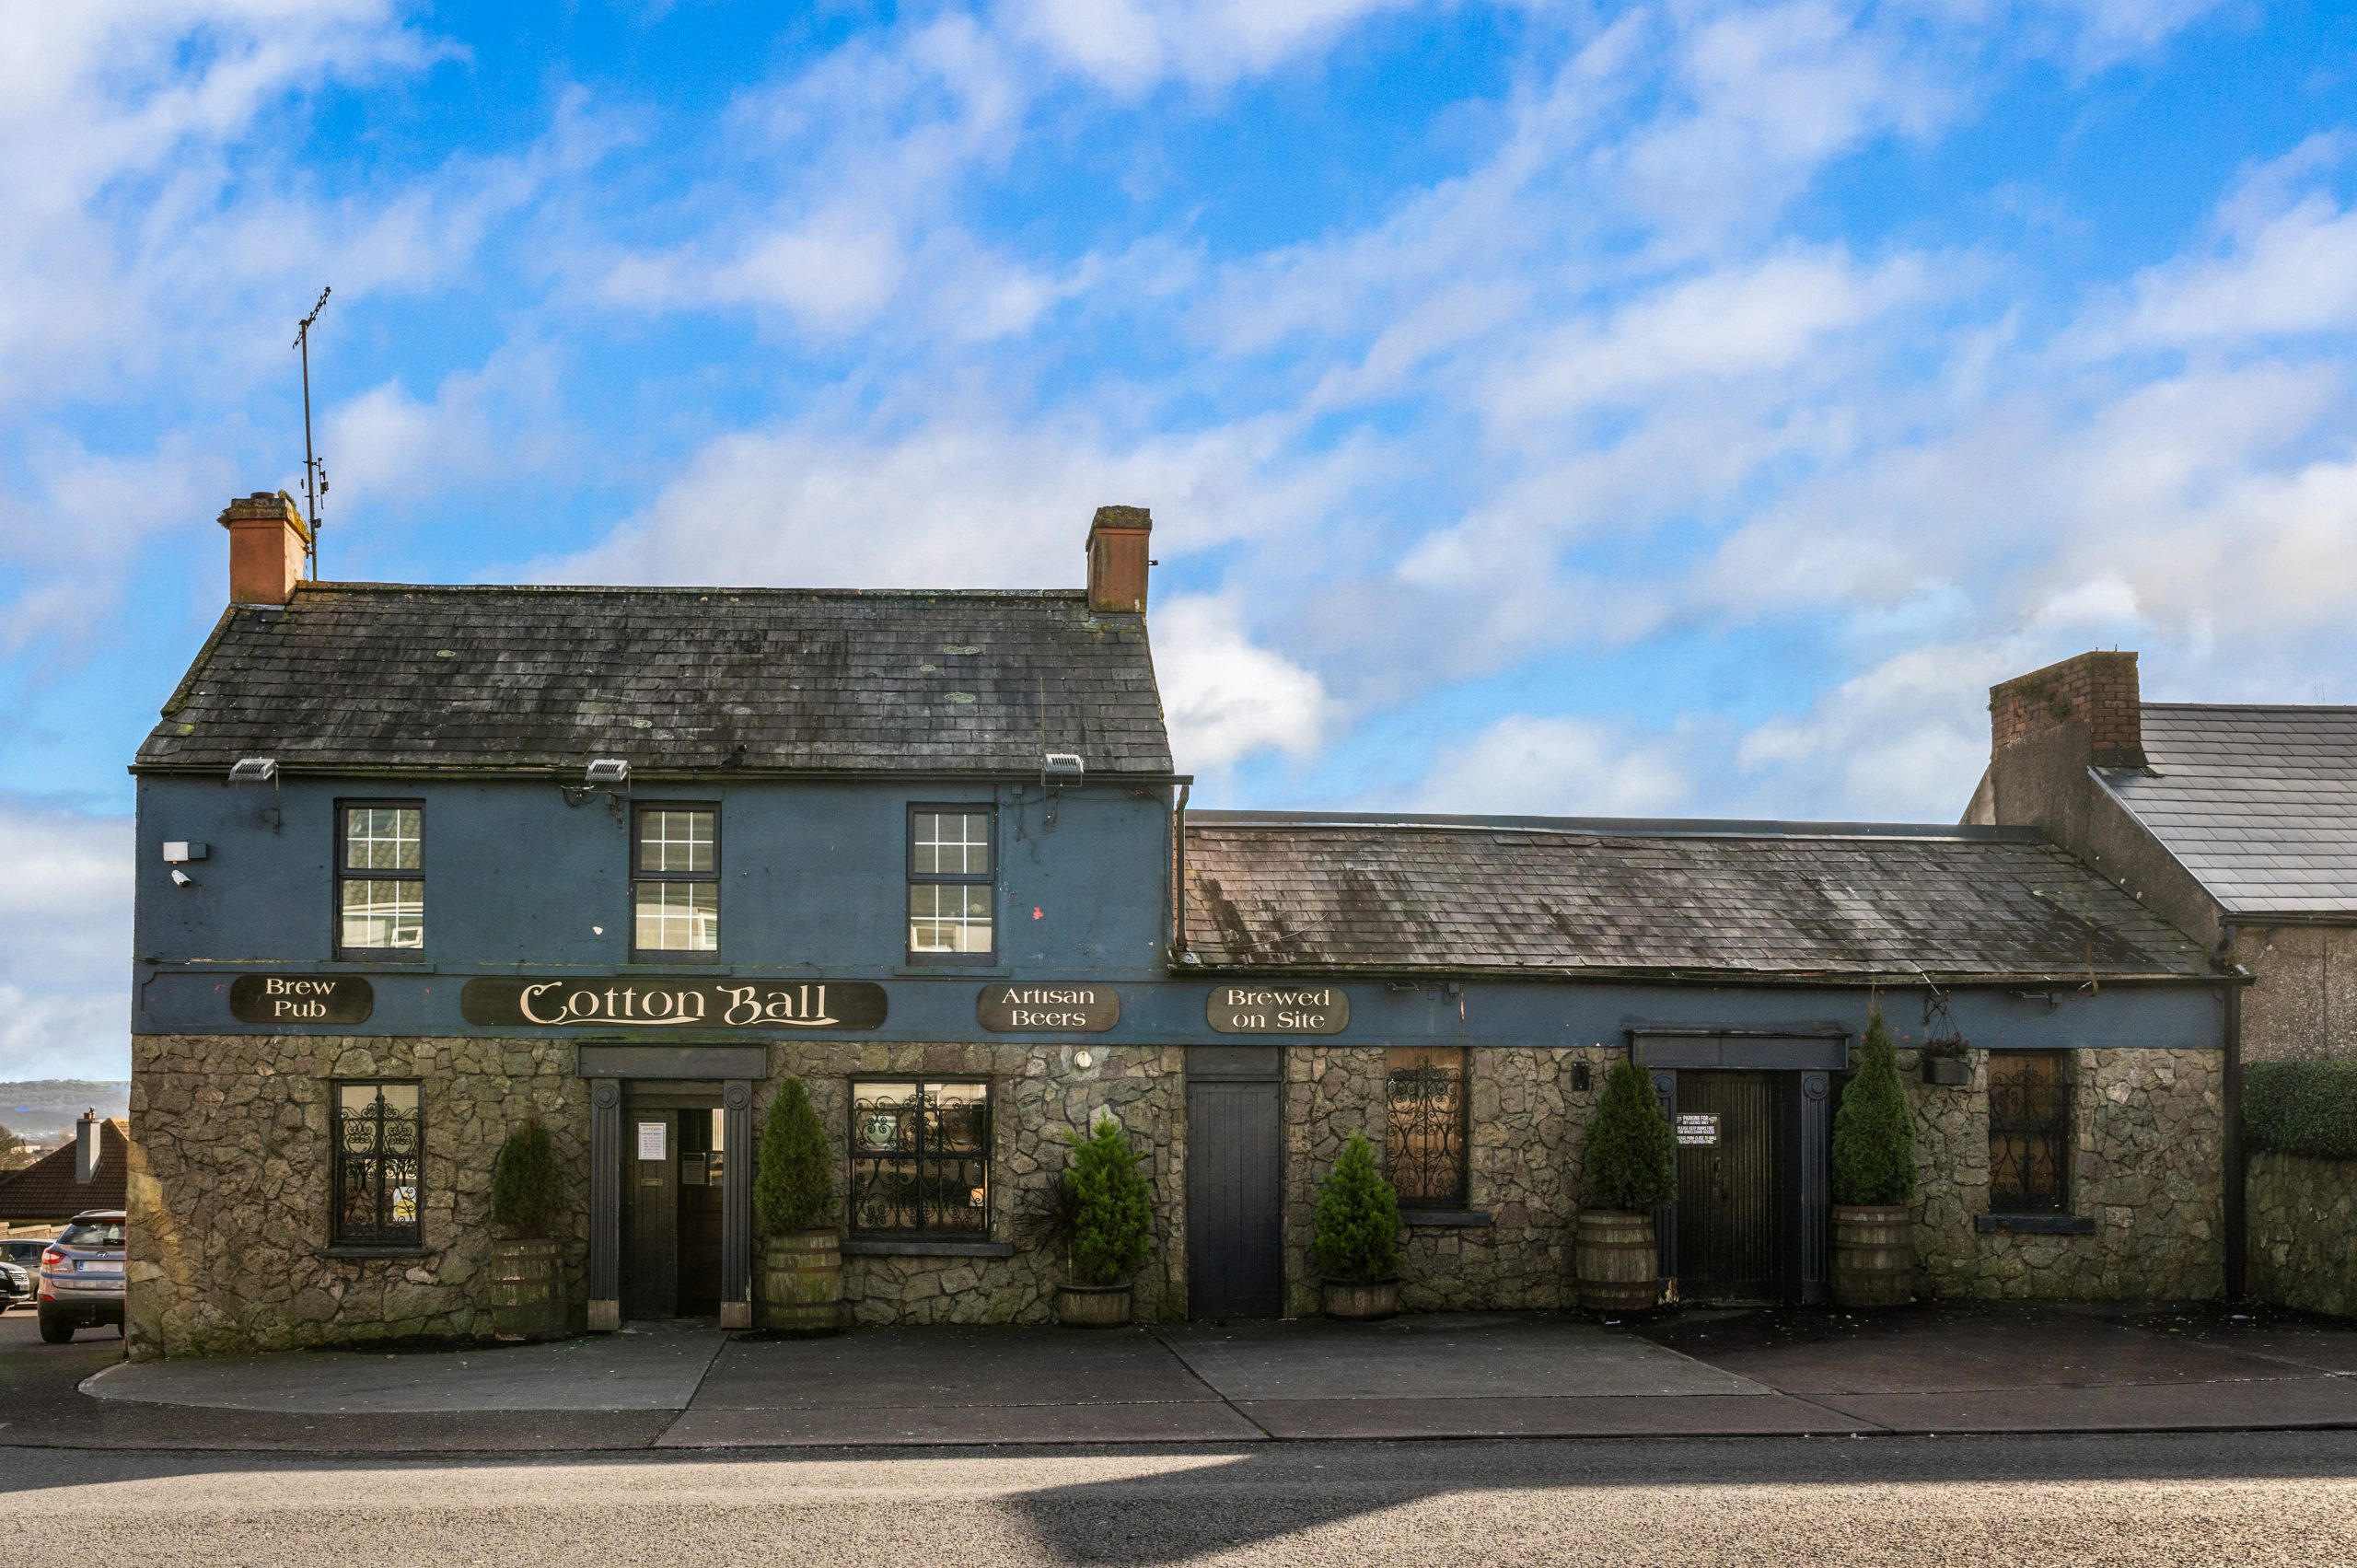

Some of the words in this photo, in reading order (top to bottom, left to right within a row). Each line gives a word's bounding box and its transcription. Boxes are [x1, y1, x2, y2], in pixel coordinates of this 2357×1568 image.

[266, 979, 336, 994] Brew
[520, 981, 706, 1025] Cotton
[715, 985, 840, 1026] Ball
[1002, 988, 1095, 1004] Artisan
[1227, 989, 1330, 1005] Brewed
[274, 1000, 327, 1017] Pub
[1012, 1010, 1086, 1026] Beers
[1232, 1014, 1266, 1028] on
[1277, 1011, 1325, 1028] Site
